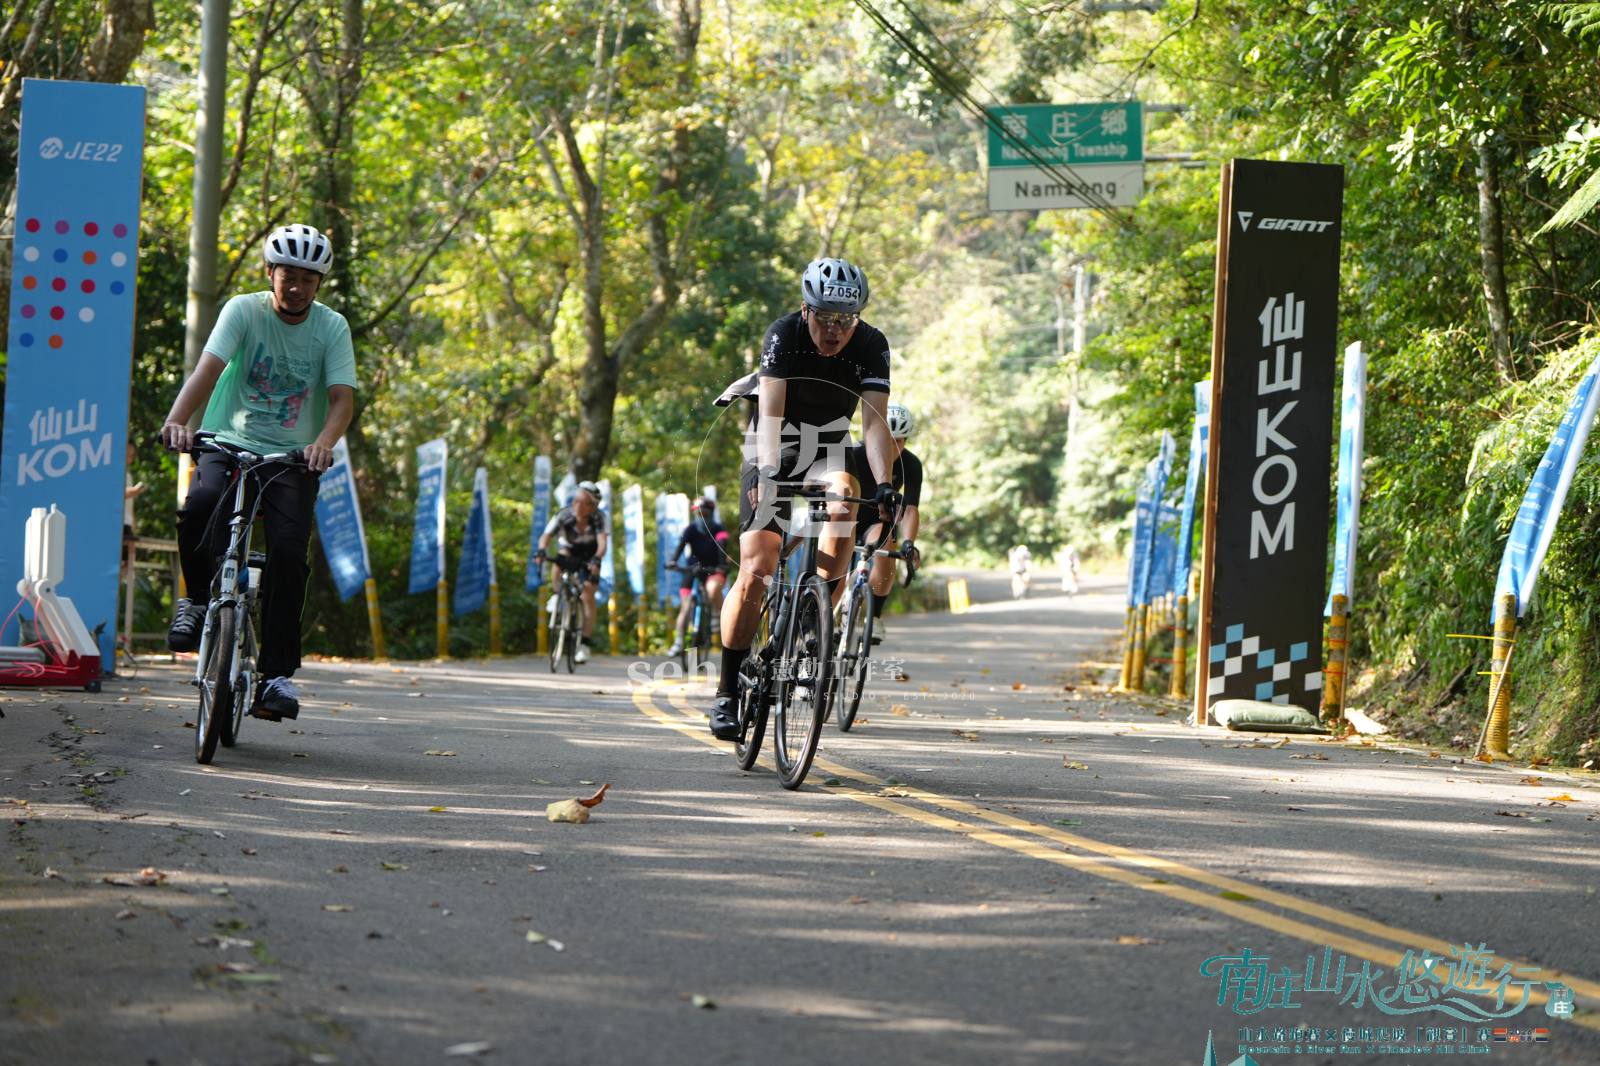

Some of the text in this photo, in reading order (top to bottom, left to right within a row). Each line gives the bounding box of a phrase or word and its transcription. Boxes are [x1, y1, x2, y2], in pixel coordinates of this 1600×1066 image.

[65, 142, 123, 163] JE22
[1257, 217, 1336, 233] GIANT
[28, 398, 98, 446] 仙山
[16, 432, 113, 487] KOM
